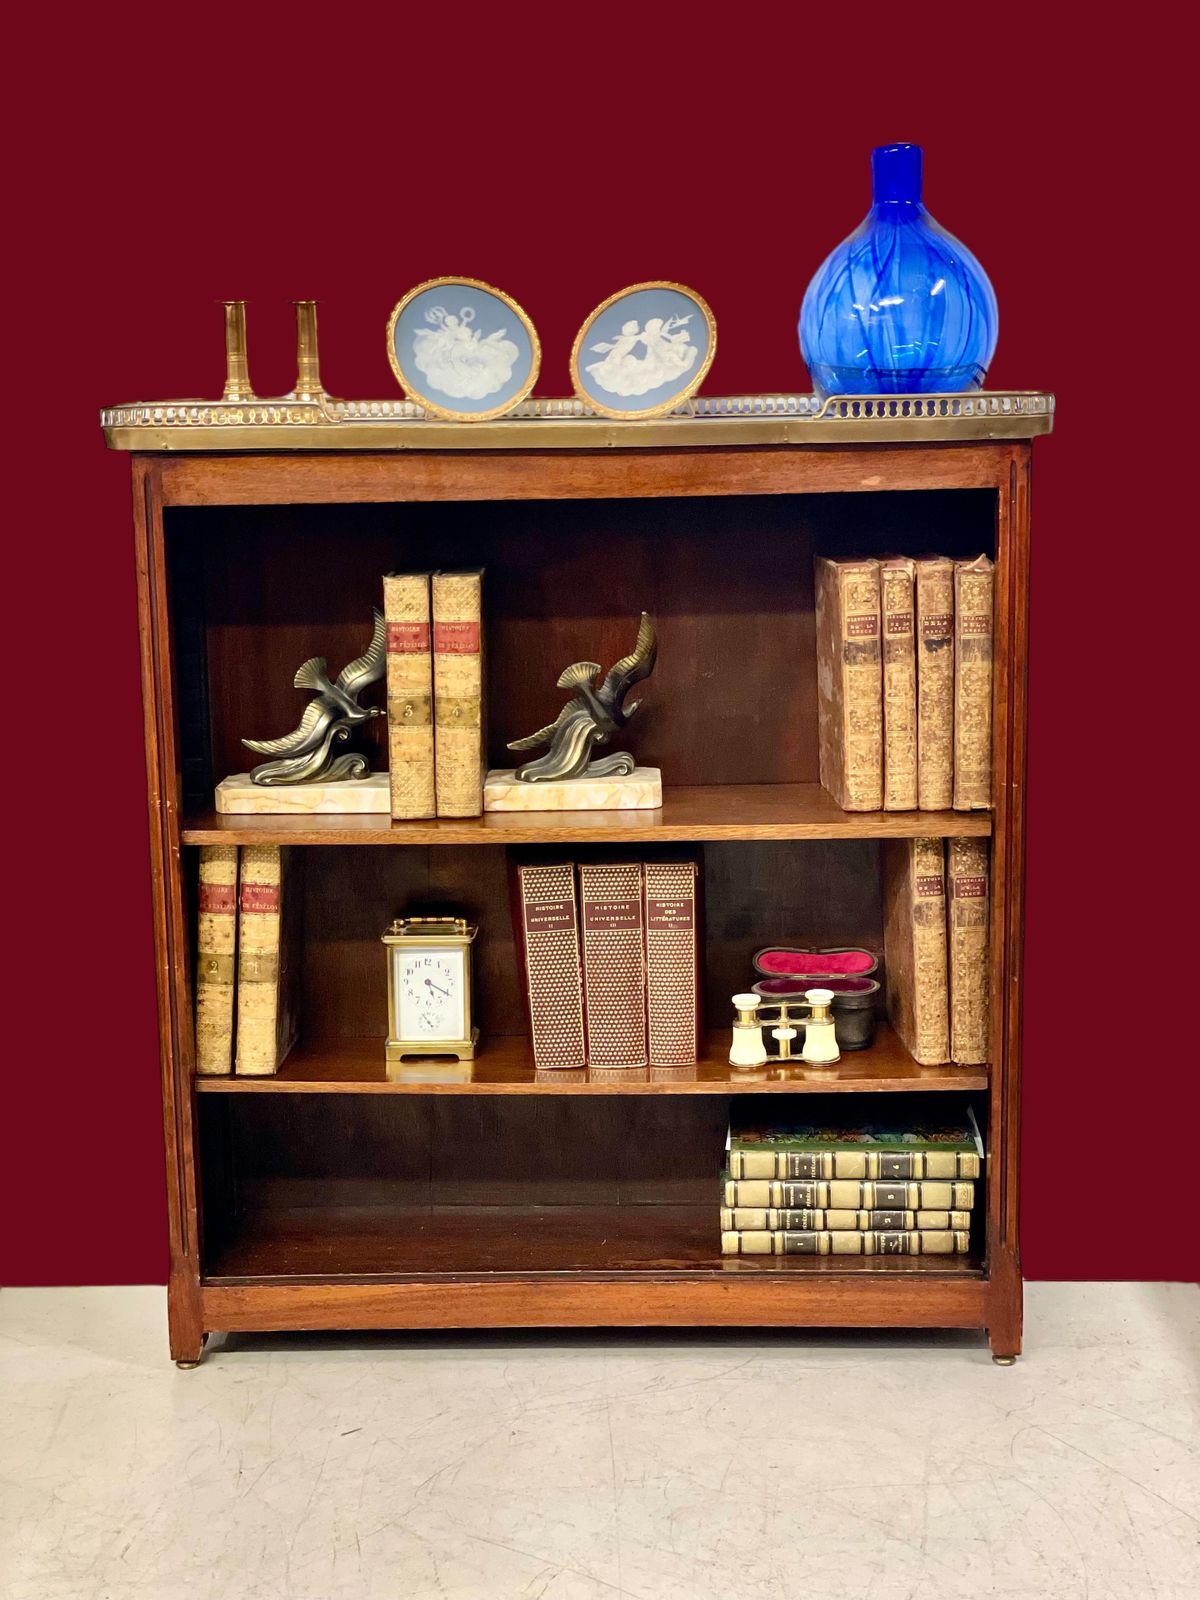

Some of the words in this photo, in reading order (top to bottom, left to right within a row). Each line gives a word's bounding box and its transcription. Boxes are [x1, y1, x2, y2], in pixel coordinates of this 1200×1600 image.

[404, 705, 413, 717] 3
[414, 960, 421, 969] 11
[424, 958, 432, 966] 12
[209, 960, 218, 974] 2
[406, 968, 414, 976] 10
[444, 969, 450, 977] 2
[407, 988, 414, 997] 8
